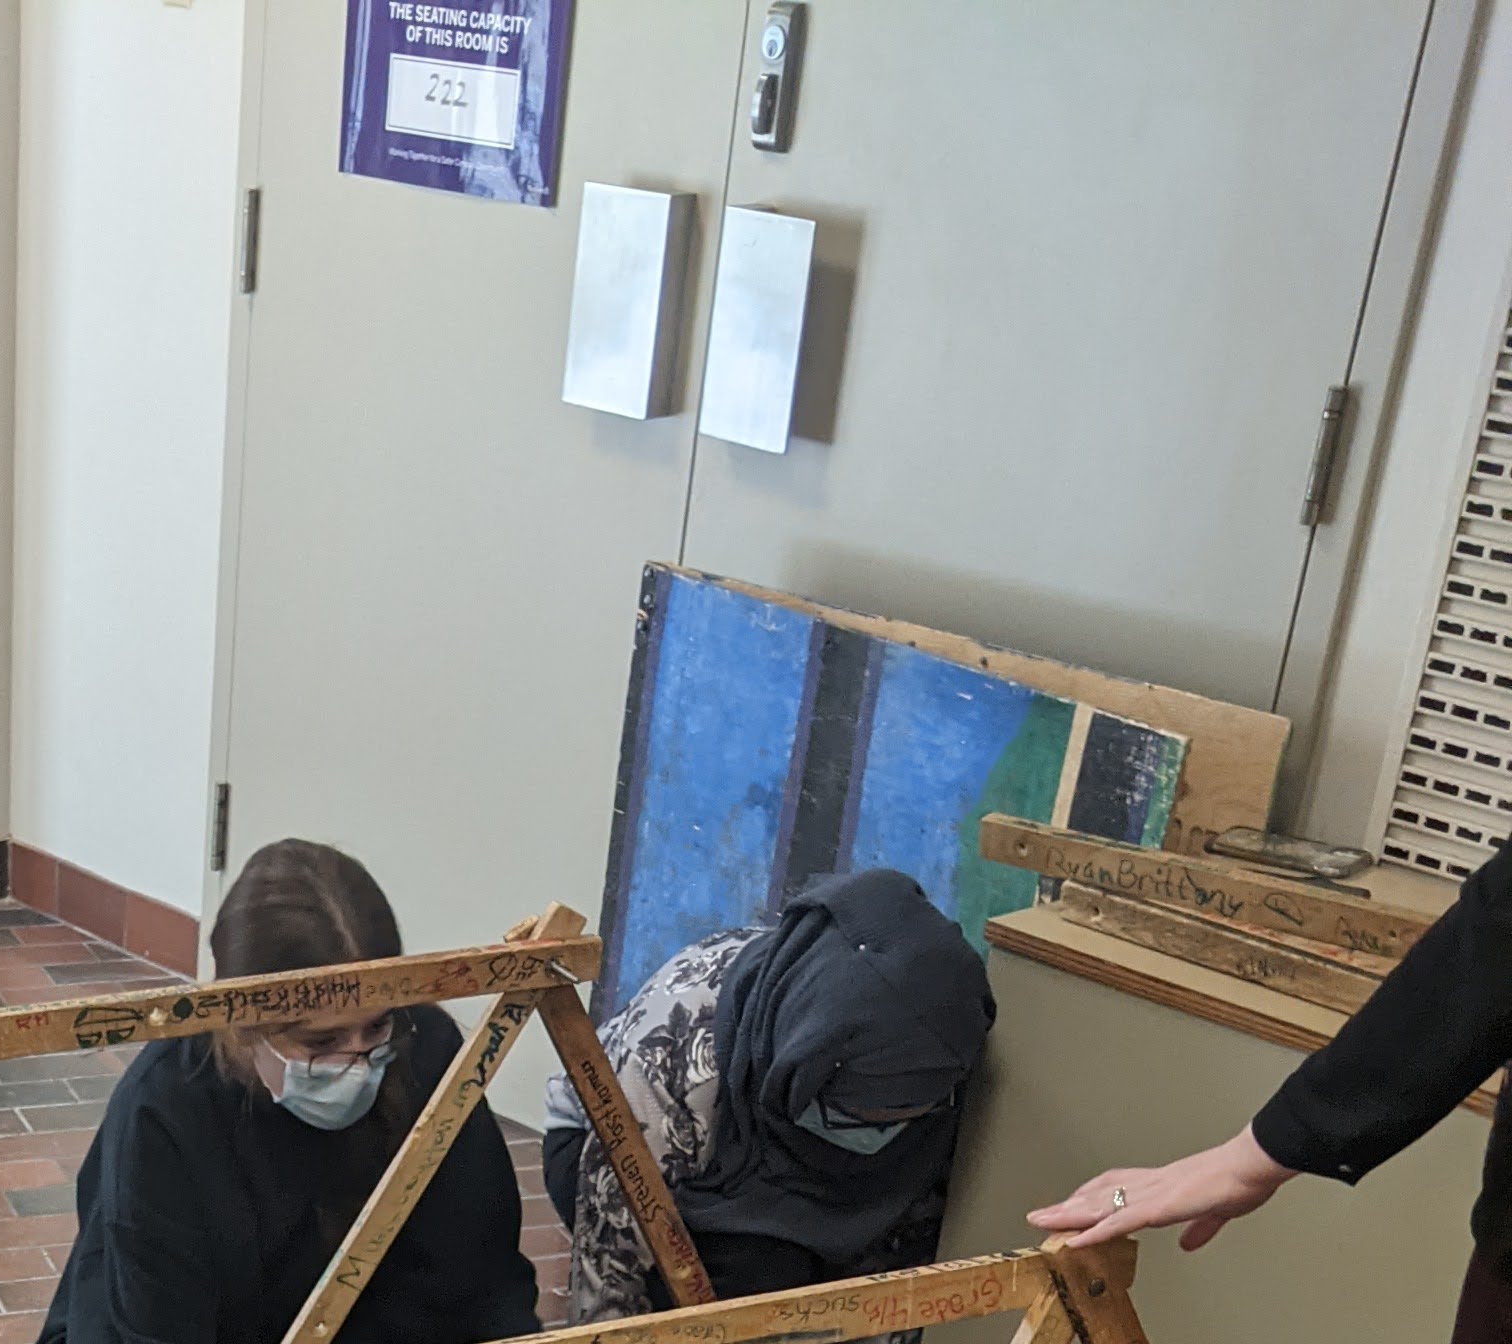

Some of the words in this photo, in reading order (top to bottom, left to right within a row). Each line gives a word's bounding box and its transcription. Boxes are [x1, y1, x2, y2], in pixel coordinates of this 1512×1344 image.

[389, 2, 413, 21] THE
[415, 5, 467, 27] SEATING
[470, 11, 532, 34] CAPACITY
[406, 25, 424, 44] OF
[425, 27, 452, 47] THIS
[455, 32, 493, 52] ROOM
[495, 36, 509, 54] IS
[424, 73, 469, 108] 222
[915, 1275, 1003, 1319] Grade
